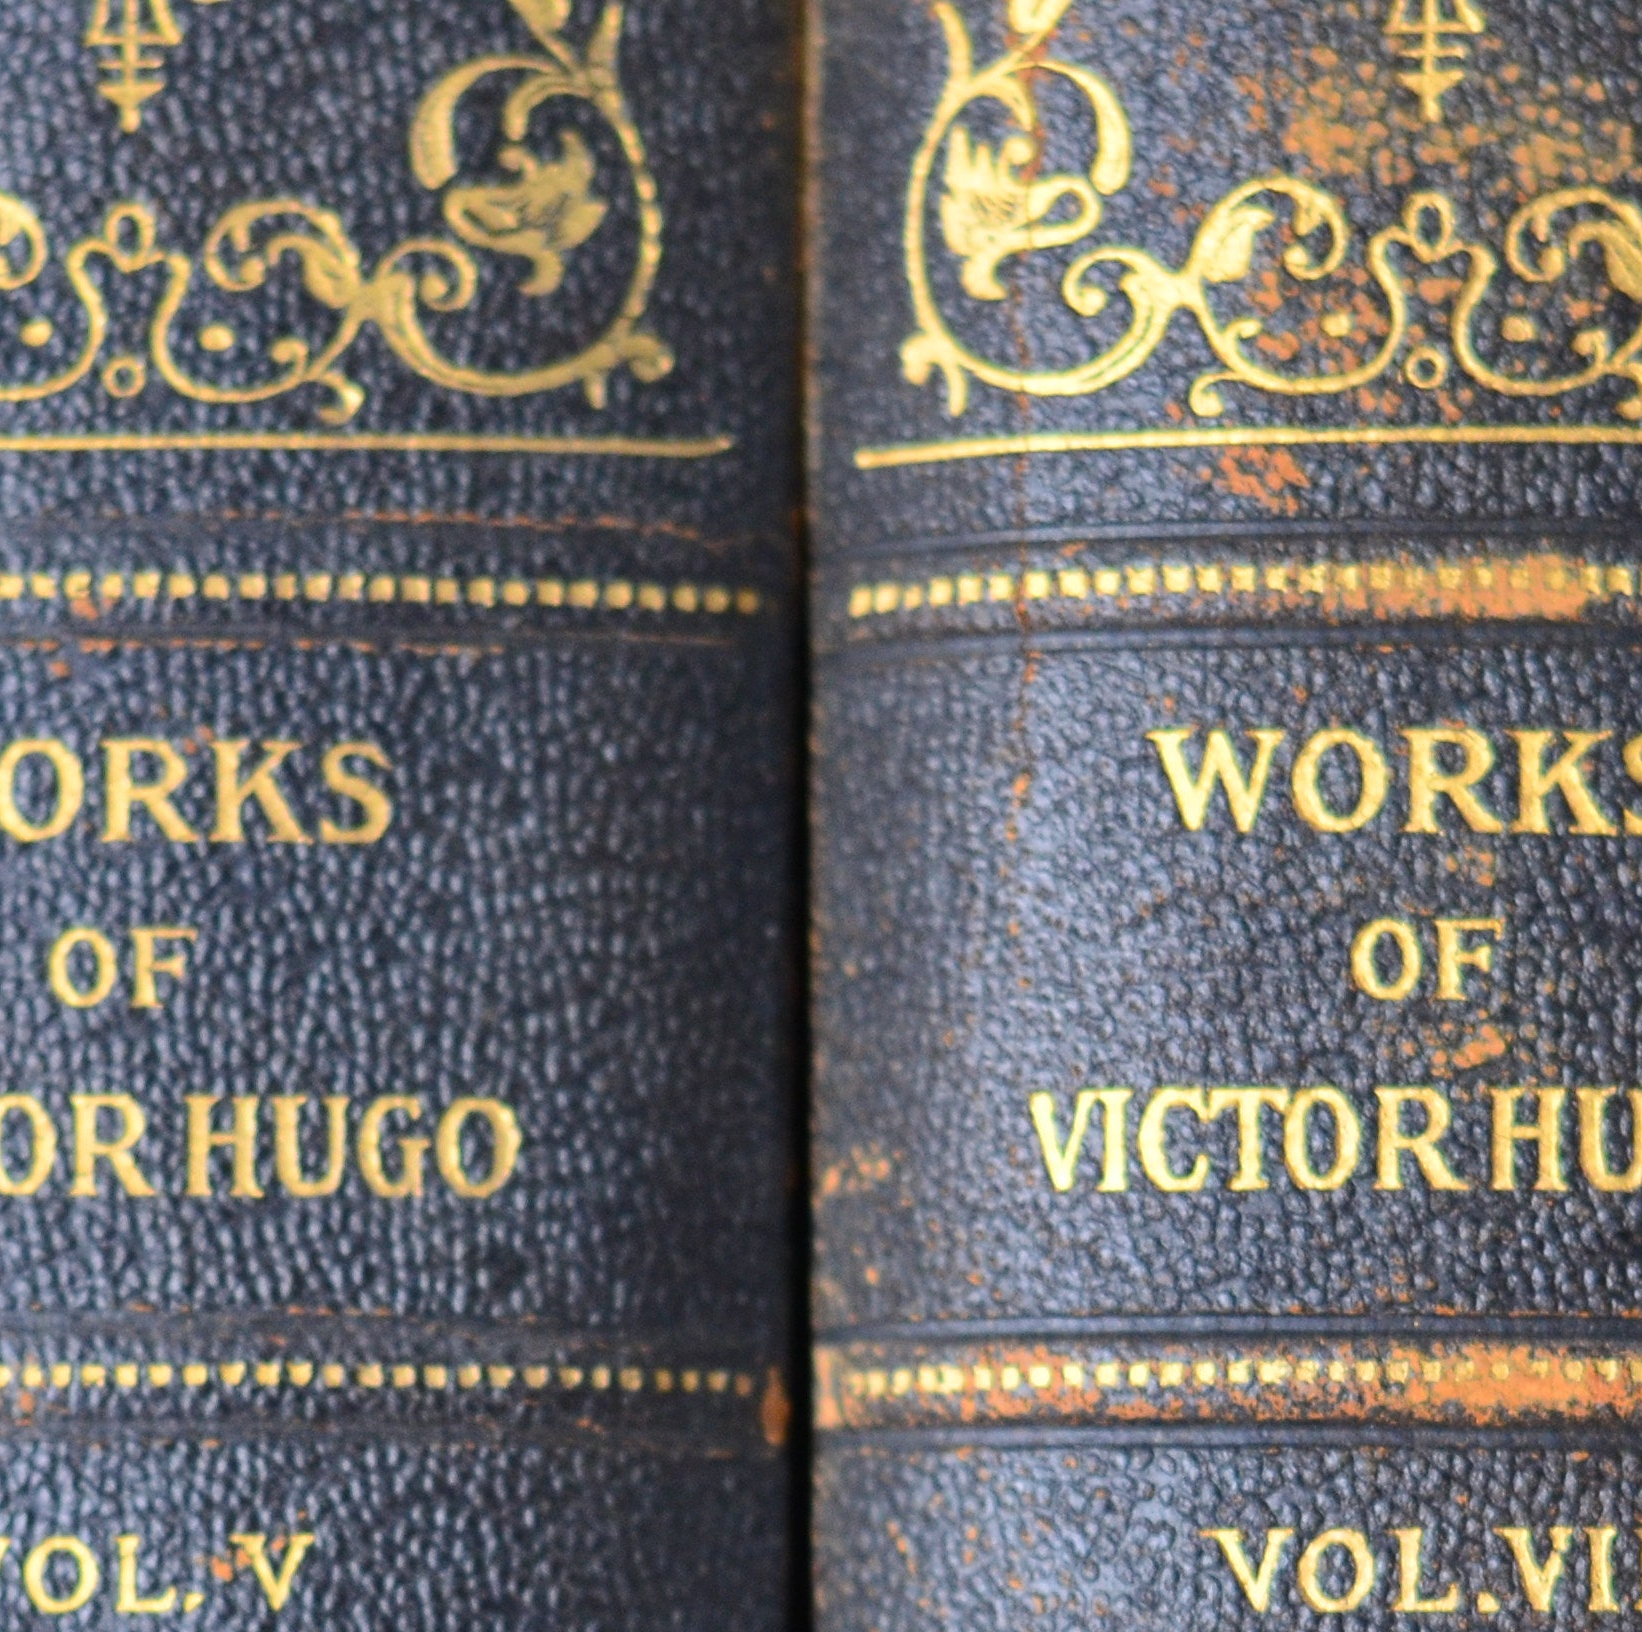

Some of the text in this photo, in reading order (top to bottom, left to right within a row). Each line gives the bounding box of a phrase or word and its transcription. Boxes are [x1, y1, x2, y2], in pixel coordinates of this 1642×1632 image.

[48, 926, 198, 1008] OF
[1352, 917, 1504, 1001] OF
[185, 1096, 522, 1197] HUGO
[1028, 1087, 1464, 1193] VICTOR
